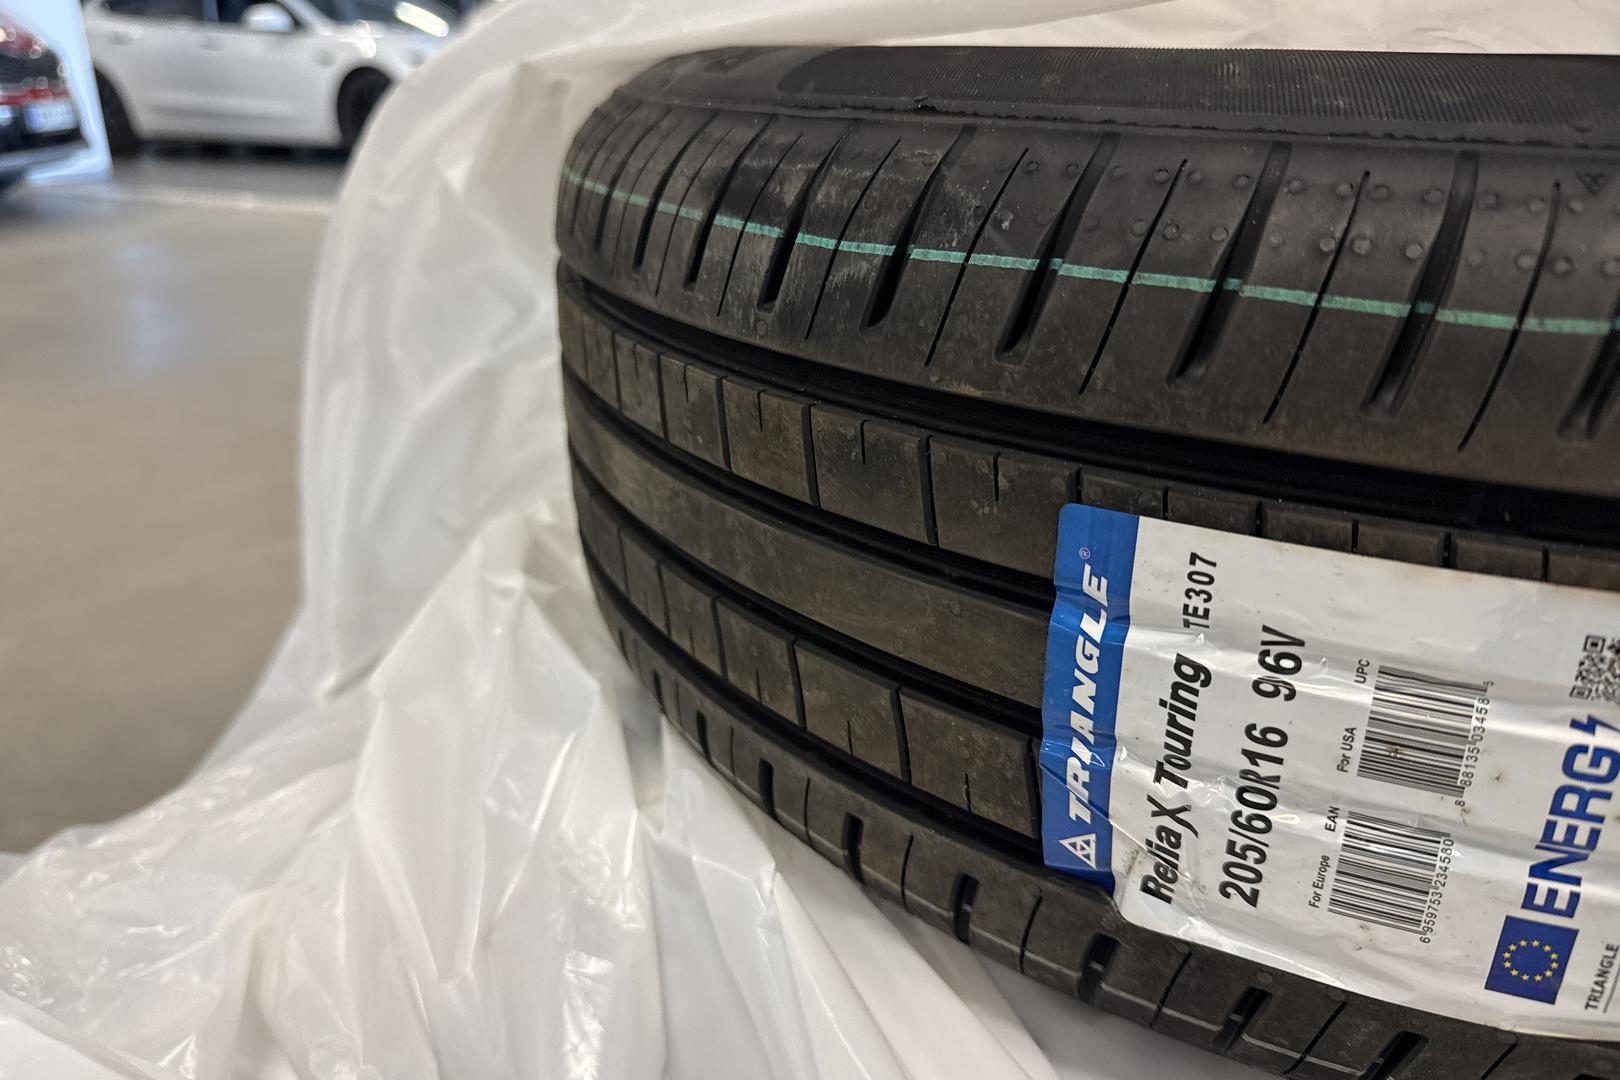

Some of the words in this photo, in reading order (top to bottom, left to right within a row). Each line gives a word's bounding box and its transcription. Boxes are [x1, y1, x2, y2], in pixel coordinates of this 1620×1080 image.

[1182, 552, 1217, 629] TE307
[1251, 624, 1305, 702] 96V
[1354, 659, 1370, 684] UPC
[1153, 652, 1212, 789] Touring
[1340, 727, 1357, 752] USA
[1336, 753, 1351, 773] For
[1218, 723, 1288, 908] 205/60R16
[1324, 806, 1340, 832] EAN
[1312, 854, 1331, 890] Europe
[1308, 890, 1322, 908] For
[1584, 942, 1620, 1011] TRIANGLE
